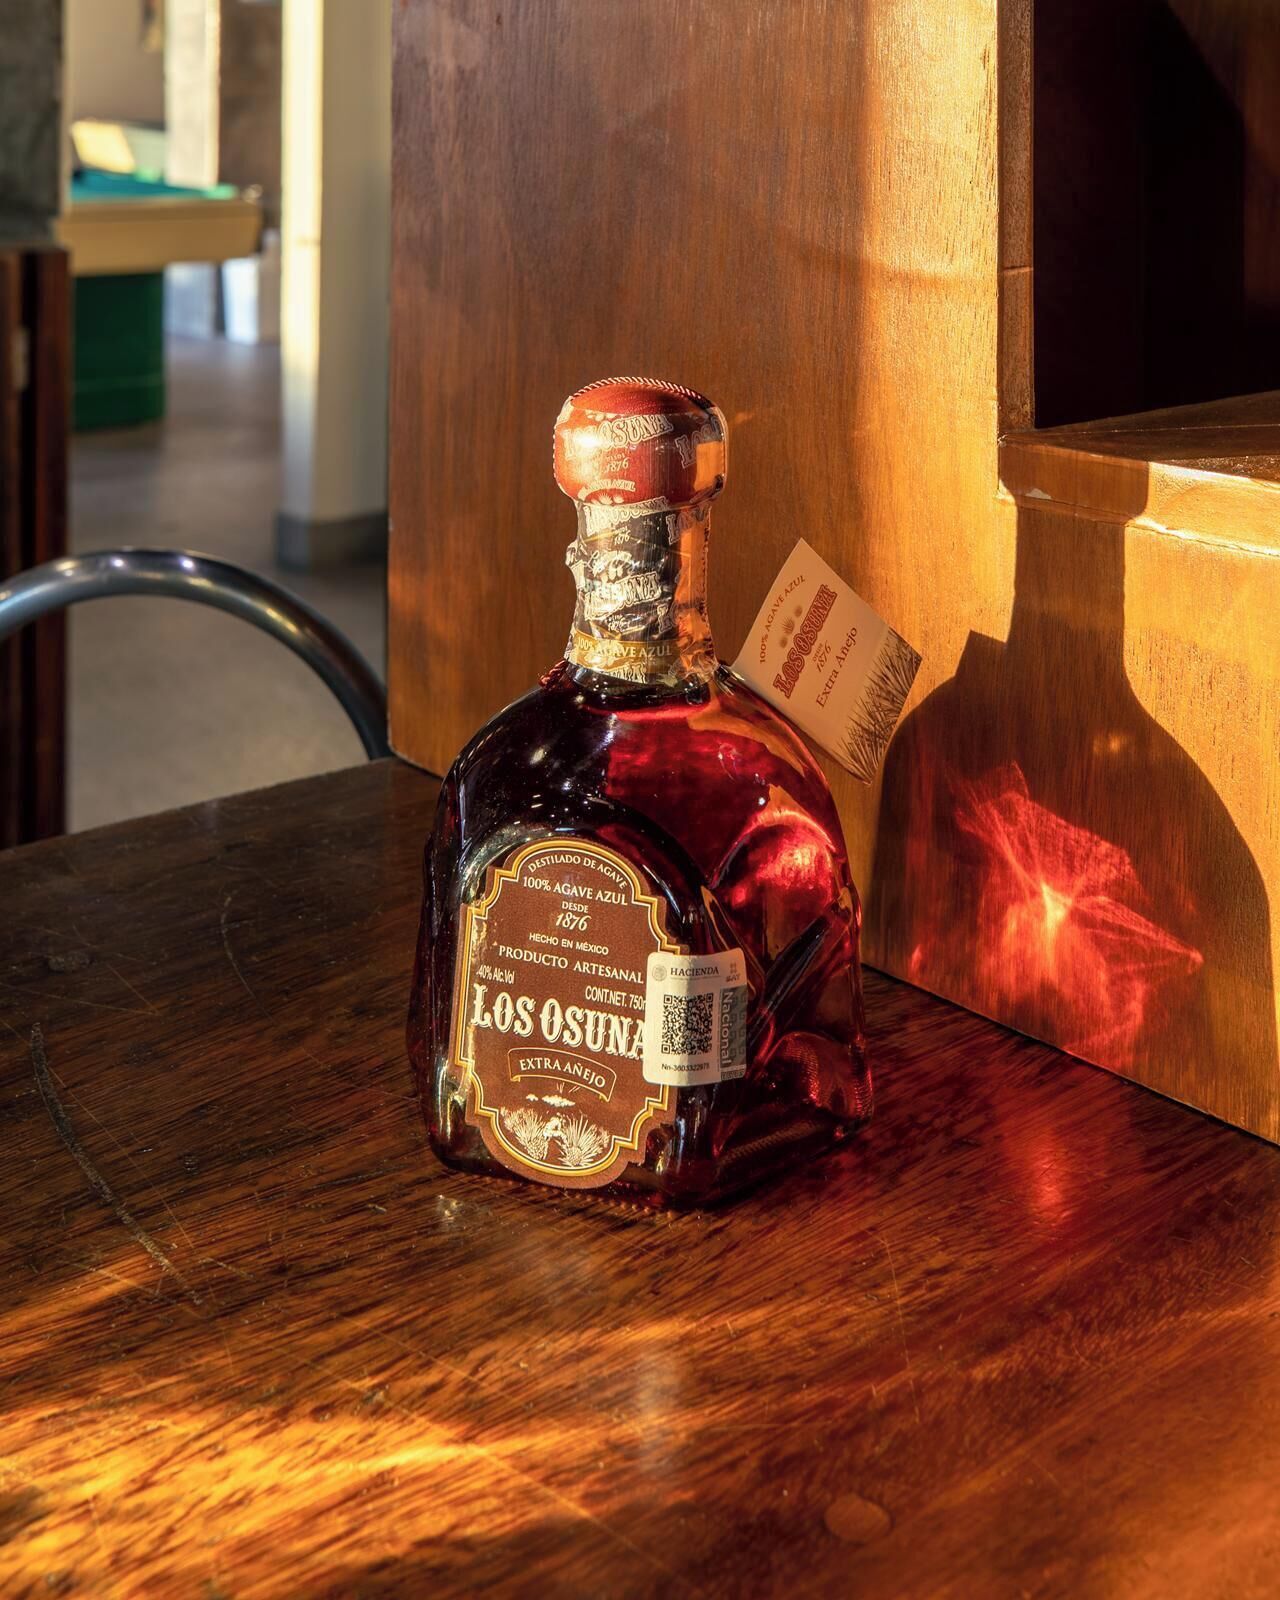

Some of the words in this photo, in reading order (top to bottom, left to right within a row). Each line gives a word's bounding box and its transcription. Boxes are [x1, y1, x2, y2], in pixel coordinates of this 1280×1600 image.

[604, 457, 630, 473] 1876
[760, 634, 769, 664] 100%
[765, 594, 785, 632] AGAVE
[783, 575, 806, 596] AZUL
[639, 645, 673, 657] AZUL
[773, 646, 806, 699] LOS
[793, 583, 838, 656] OSUNA
[816, 639, 832, 673] 1876
[816, 669, 839, 708] Extra
[836, 627, 858, 669] Añejo
[527, 854, 581, 873] DESTILADO
[583, 857, 597, 870] DE
[597, 863, 628, 890] AGAVE
[523, 876, 552, 892] 100%
[553, 883, 593, 900] AGAVE
[595, 891, 628, 906] AZUL
[561, 901, 589, 914] DESDE
[555, 912, 592, 932] 1876
[529, 932, 559, 946] HECHO
[561, 938, 573, 949] EN
[575, 941, 609, 956] MÉXICO
[498, 945, 568, 969] PRODUCTO
[573, 960, 644, 984] ARTESANAL
[670, 967, 720, 977] HACIENDA
[470, 983, 536, 1037] LOS
[539, 998, 646, 1061] OSUNA
[721, 991, 733, 1065] Nacional
[519, 1057, 561, 1071] EXTRA
[564, 1062, 606, 1089] AÑEJO
